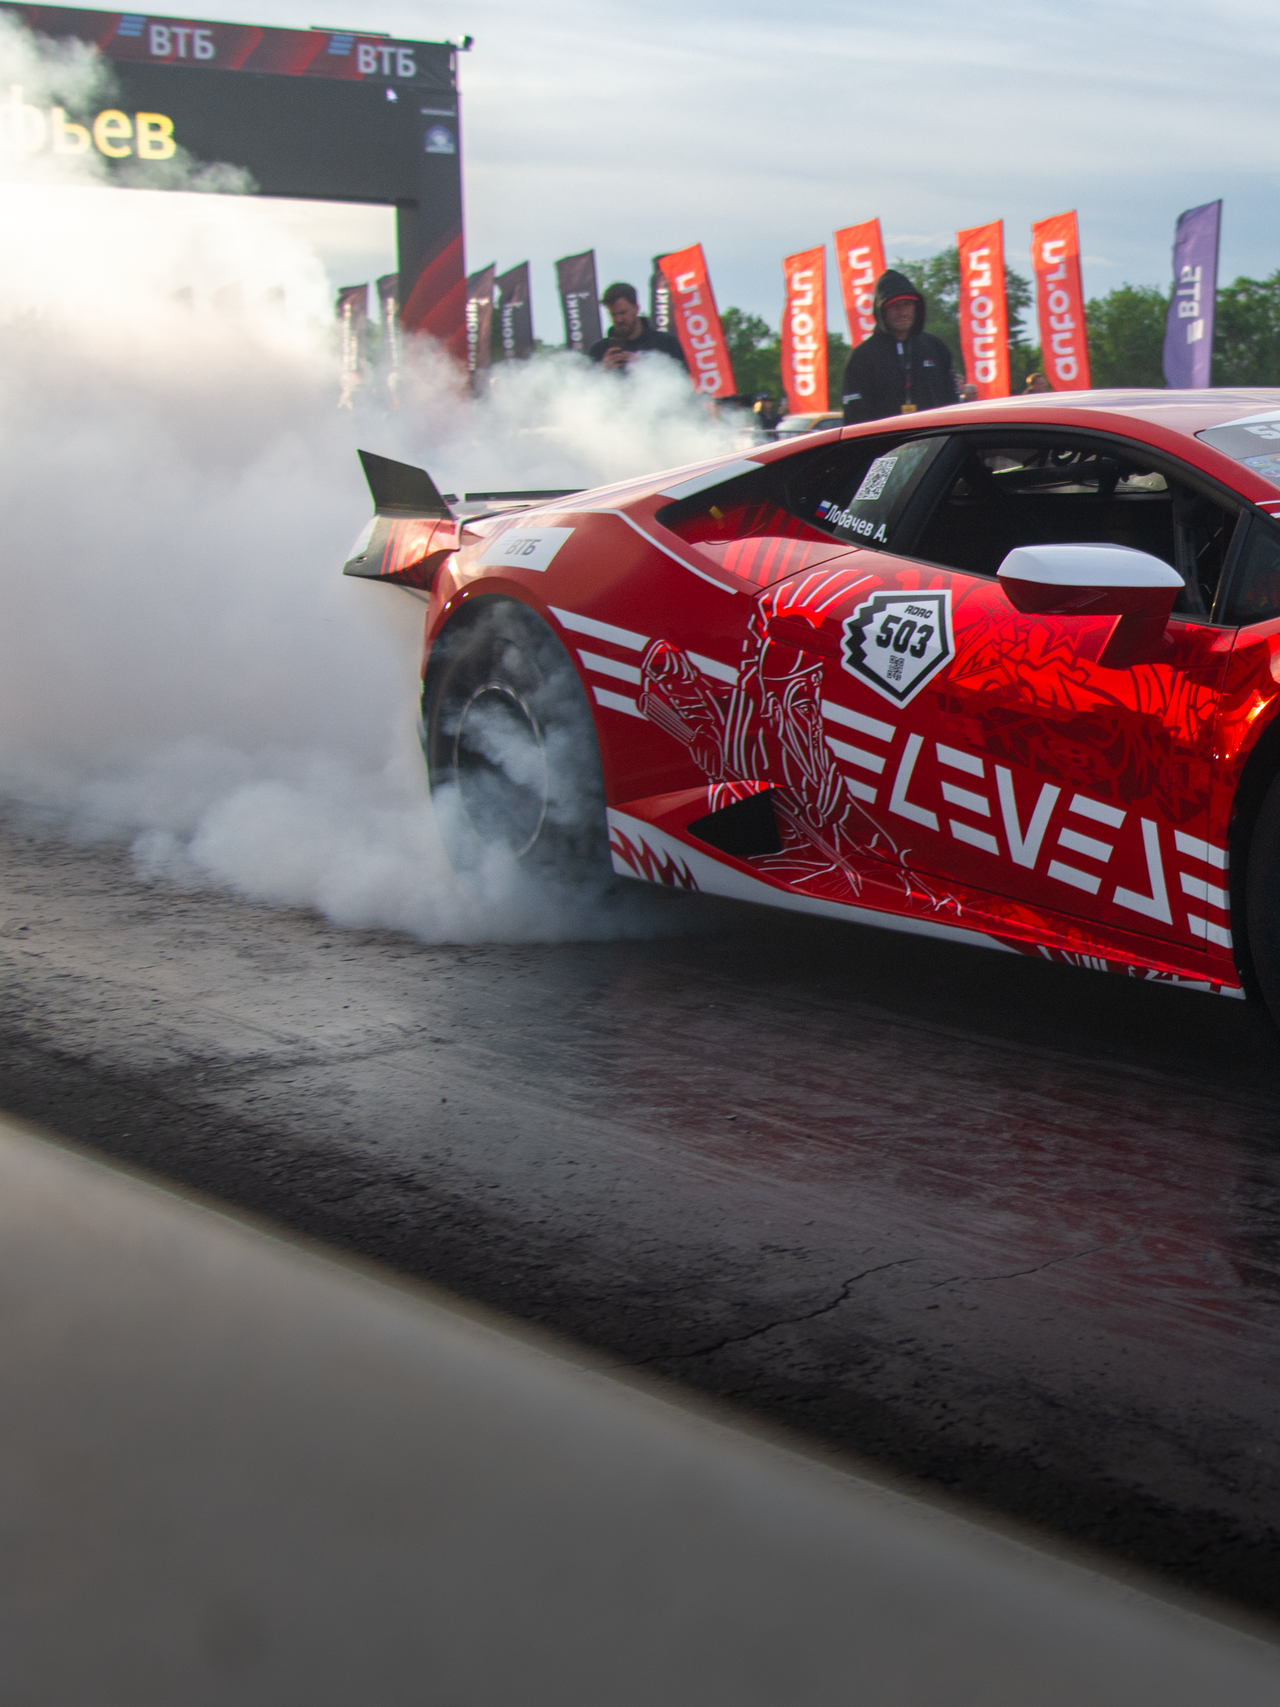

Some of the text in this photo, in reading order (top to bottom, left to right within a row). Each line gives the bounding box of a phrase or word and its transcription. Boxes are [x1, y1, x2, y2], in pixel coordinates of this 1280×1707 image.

[149, 24, 216, 60] ВТБ
[357, 45, 417, 78] ВТБ
[825, 504, 874, 537] Лобачев
[504, 538, 542, 555] ВТБ
[904, 605, 933, 619] RDRC
[875, 614, 934, 659] 503
